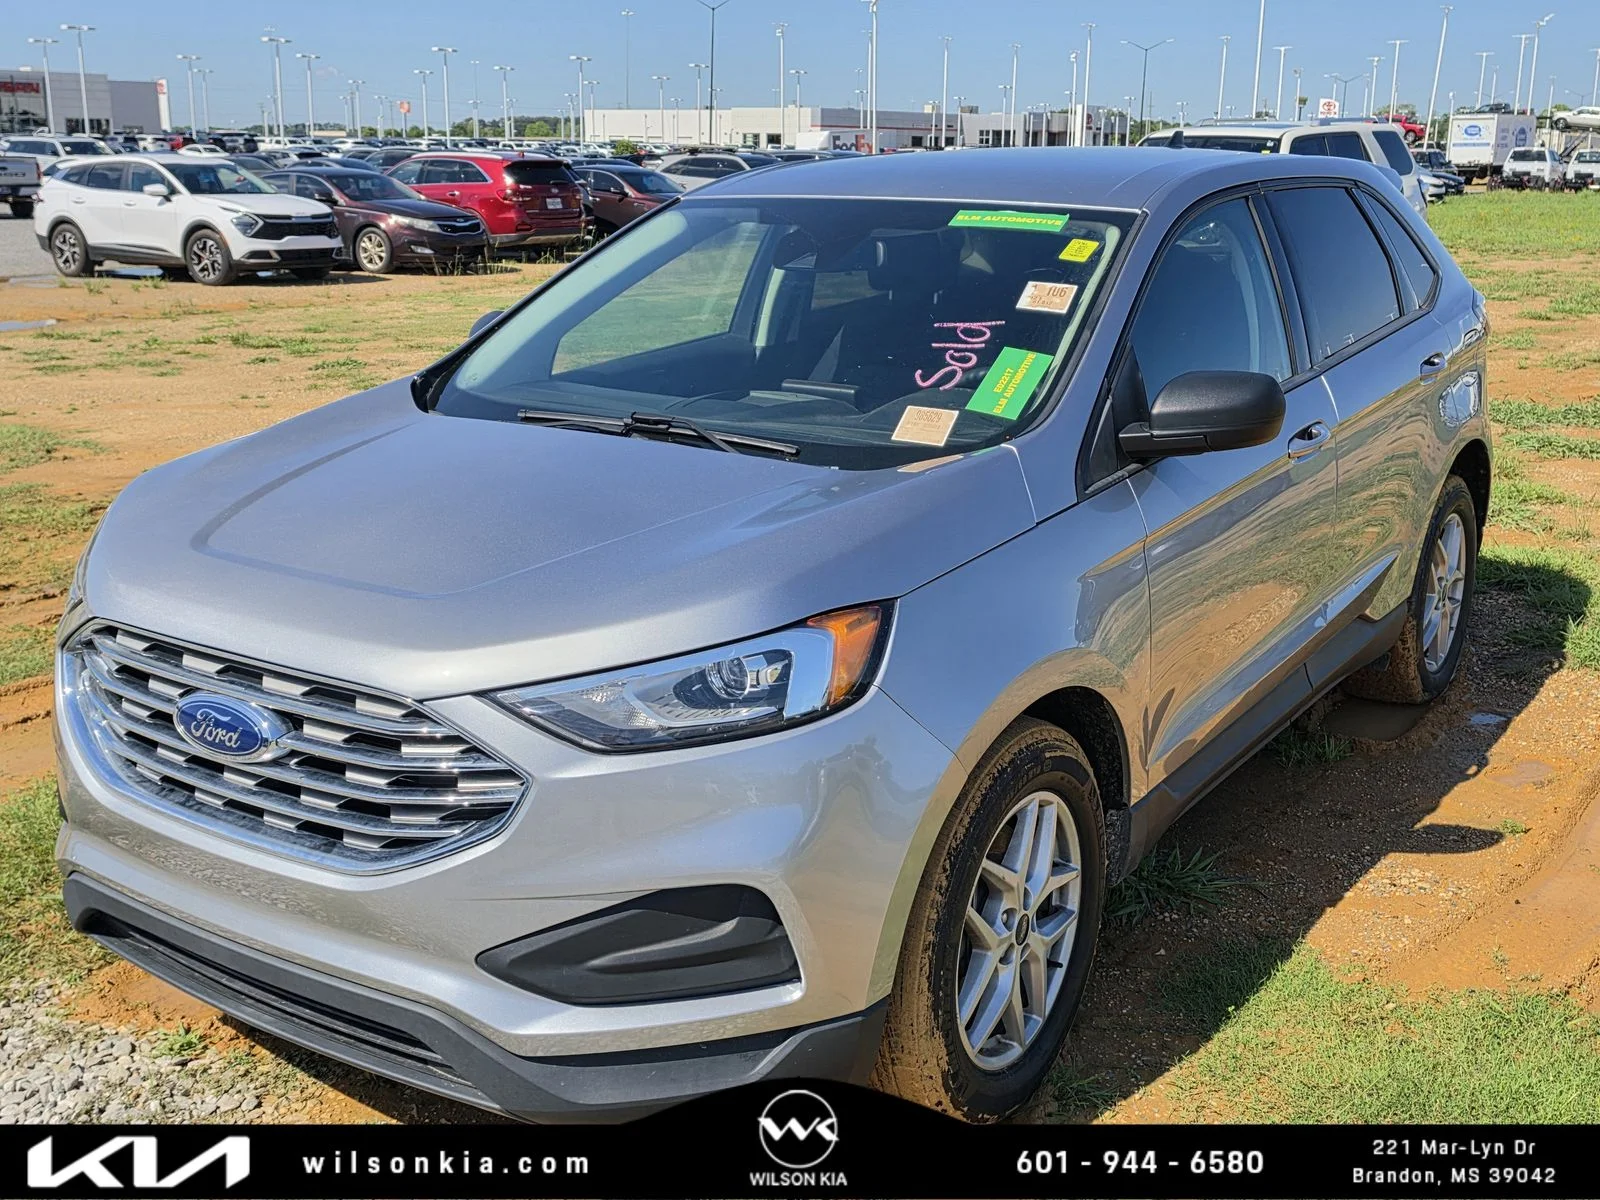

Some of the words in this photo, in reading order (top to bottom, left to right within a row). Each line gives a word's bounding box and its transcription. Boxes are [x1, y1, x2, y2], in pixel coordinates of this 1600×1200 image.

[983, 215, 1063, 225] AUTOMOTIVE
[914, 320, 1006, 391] Sold
[1003, 351, 1037, 399] AUTOMOTIVE
[993, 367, 1014, 393] ED2217
[190, 708, 241, 747] Ford
